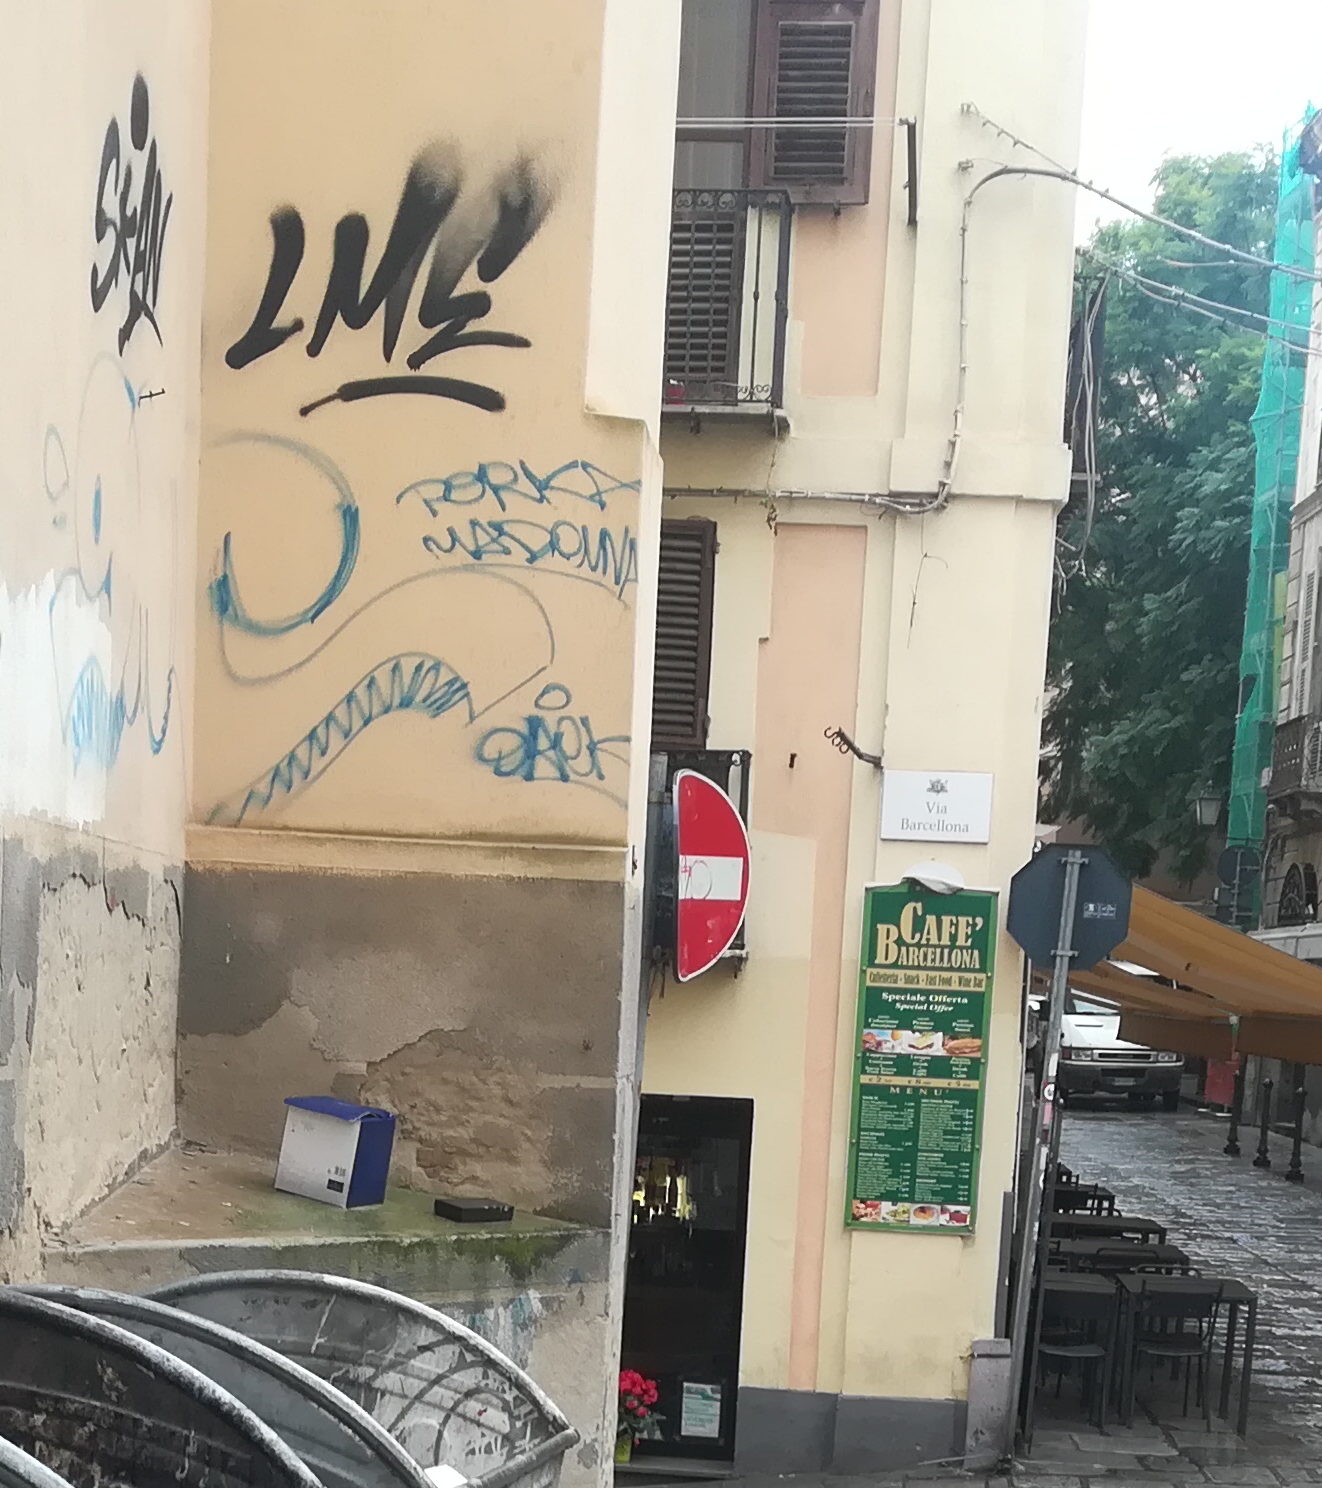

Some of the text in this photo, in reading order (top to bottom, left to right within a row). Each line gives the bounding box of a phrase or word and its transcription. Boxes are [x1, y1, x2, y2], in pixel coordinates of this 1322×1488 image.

[926, 801, 948, 814] Via
[900, 817, 969, 833] Barcellona
[874, 923, 980, 969] BARCELLONA
[881, 991, 968, 1004] Speciale Offerta
[895, 1002, 927, 1011] Special
